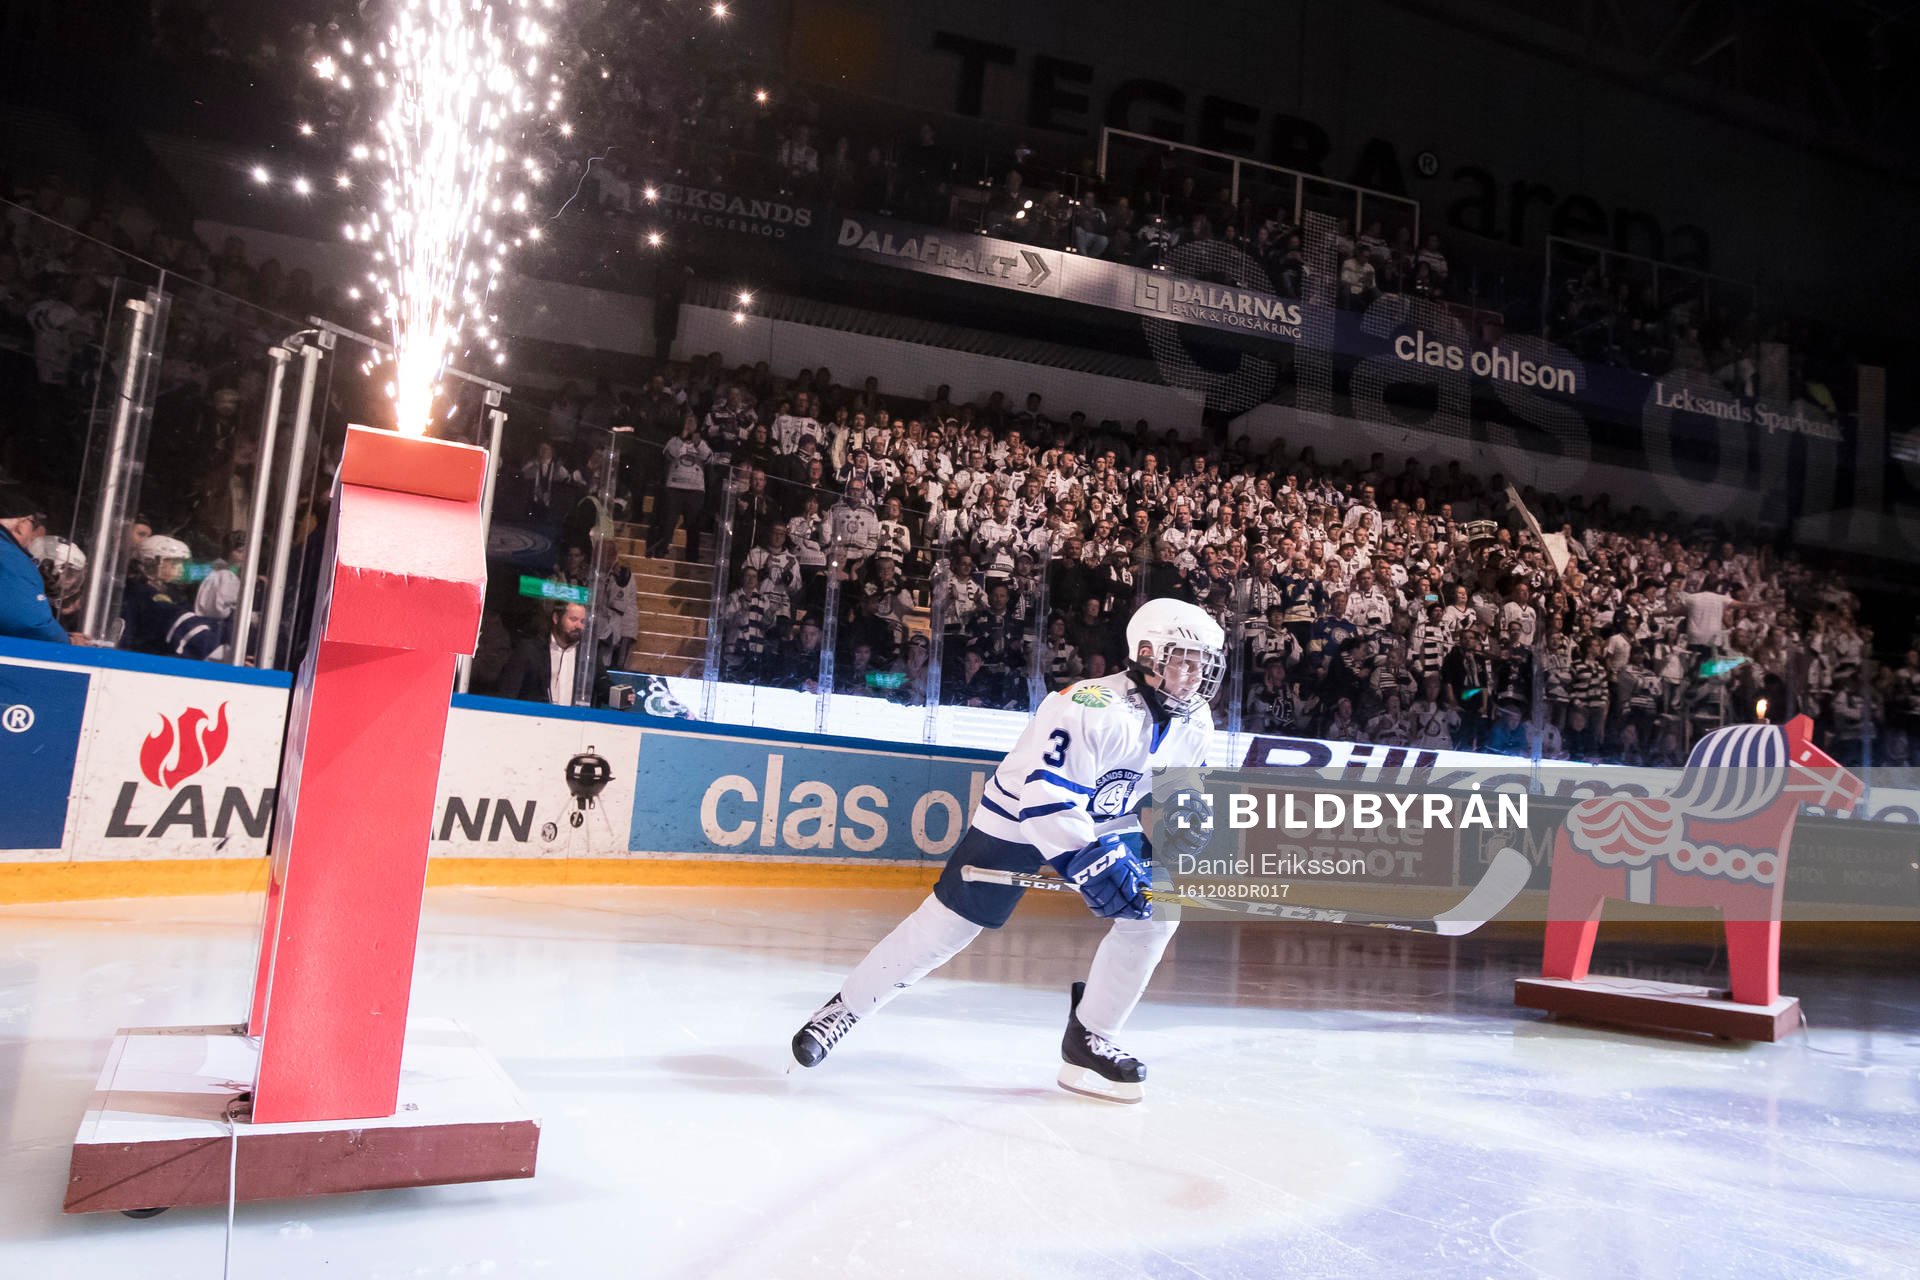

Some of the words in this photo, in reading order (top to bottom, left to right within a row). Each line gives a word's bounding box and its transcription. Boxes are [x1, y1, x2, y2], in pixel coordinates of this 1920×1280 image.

[652, 182, 812, 228] EKSANDS
[1172, 280, 1303, 326] DALARNAS
[1394, 329, 1465, 372] clas
[1470, 346, 1577, 395] ohlson
[1655, 382, 1751, 424] Leksands
[1042, 727, 1071, 768] 3
[700, 753, 890, 852] clas
[1071, 842, 1127, 885] CCM
[1019, 880, 1061, 891] CCM
[1246, 902, 1348, 924] CCM
